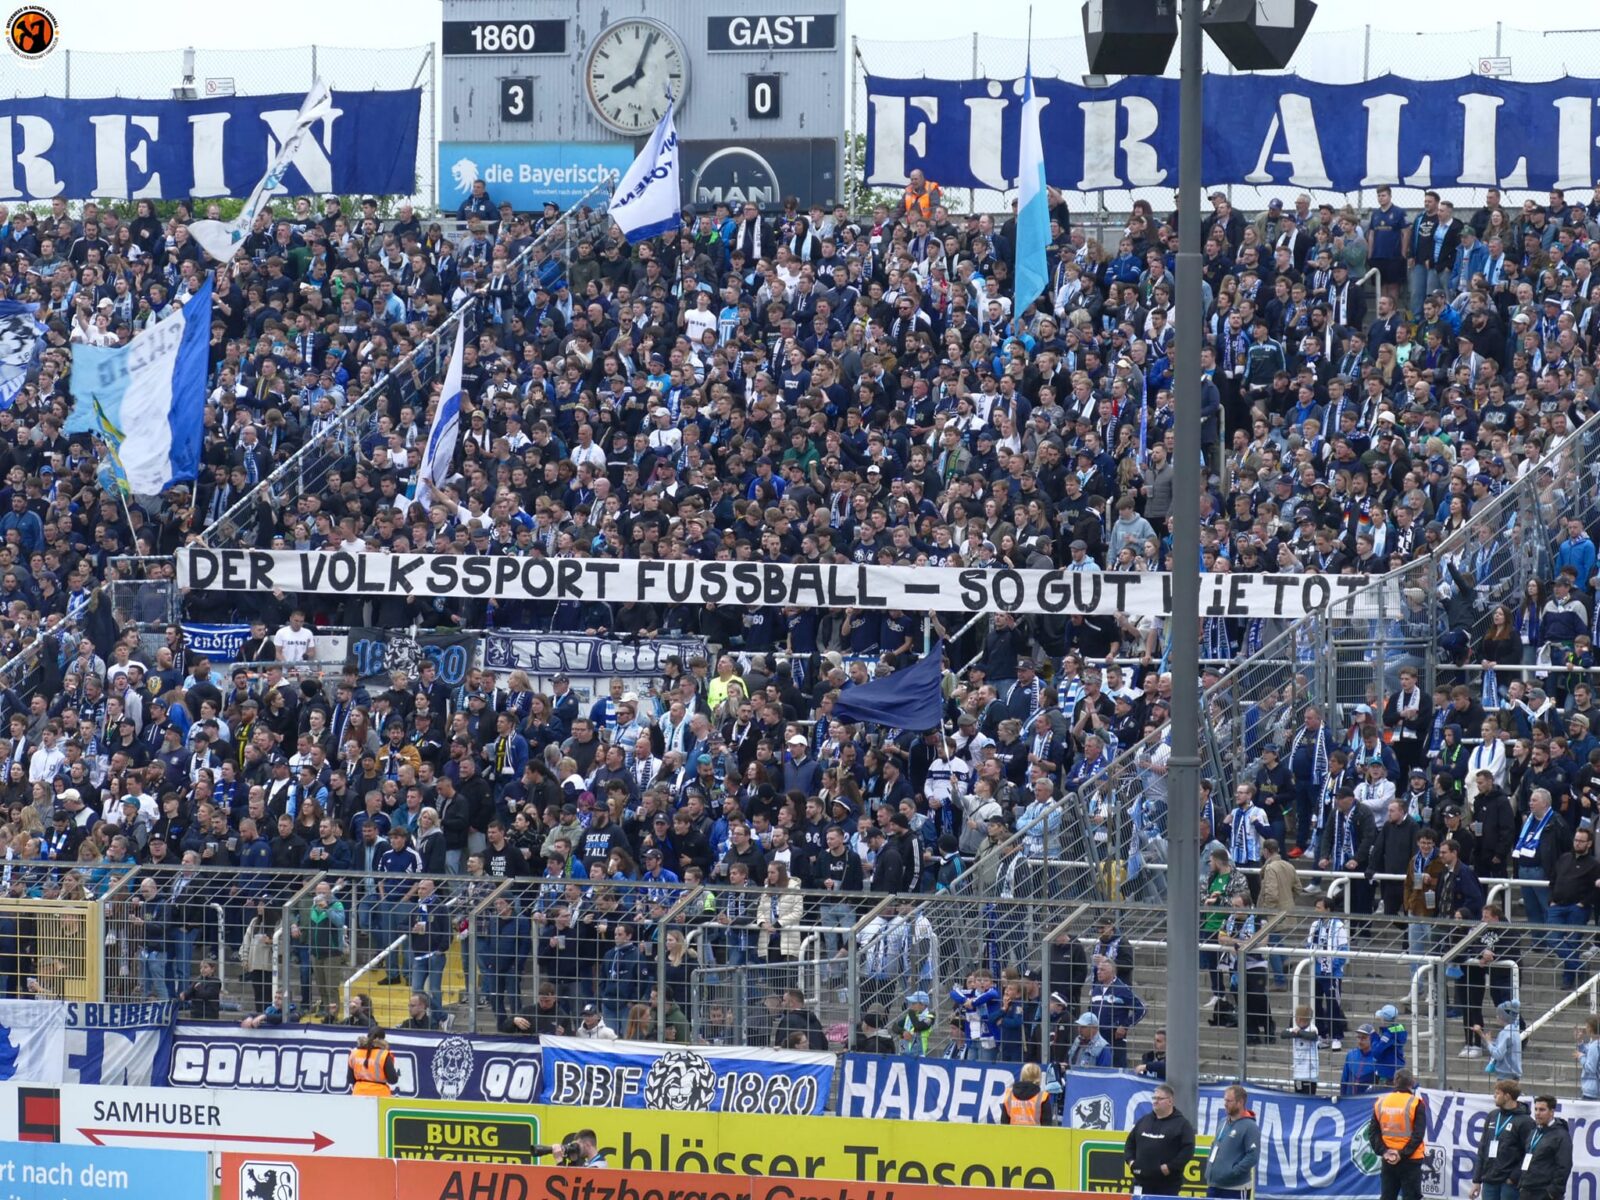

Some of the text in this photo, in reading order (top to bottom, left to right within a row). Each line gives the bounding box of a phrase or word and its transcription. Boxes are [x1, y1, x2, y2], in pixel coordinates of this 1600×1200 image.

[471, 24, 535, 51] 1860
[728, 16, 815, 46] GAST
[508, 86, 524, 115] 3
[755, 83, 771, 114] 0
[485, 163, 620, 186] die Bayerische
[699, 187, 773, 202] MAN
[189, 549, 274, 592] DER
[300, 553, 620, 601] VOLKSSPORT
[637, 560, 888, 607] FUSSBALL
[959, 569, 1024, 612] SO
[1037, 570, 1141, 612] GUT
[1262, 576, 1370, 617] TOT
[510, 639, 594, 670] TSV
[585, 834, 611, 843] SICK OF
[85, 1001, 171, 1027] BLEIBEN!
[170, 1042, 420, 1097] COMITIA
[480, 1058, 540, 1103] 90
[550, 1061, 818, 1116] BBF 1860
[840, 1060, 1048, 1122] HADER
[94, 1100, 221, 1126] SAMHUBER
[427, 1124, 499, 1147] BURG
[22, 1164, 73, 1186] nach
[80, 1164, 129, 1188] dem
[844, 1145, 1056, 1191] Tresore
[439, 1171, 529, 1200] AHD
